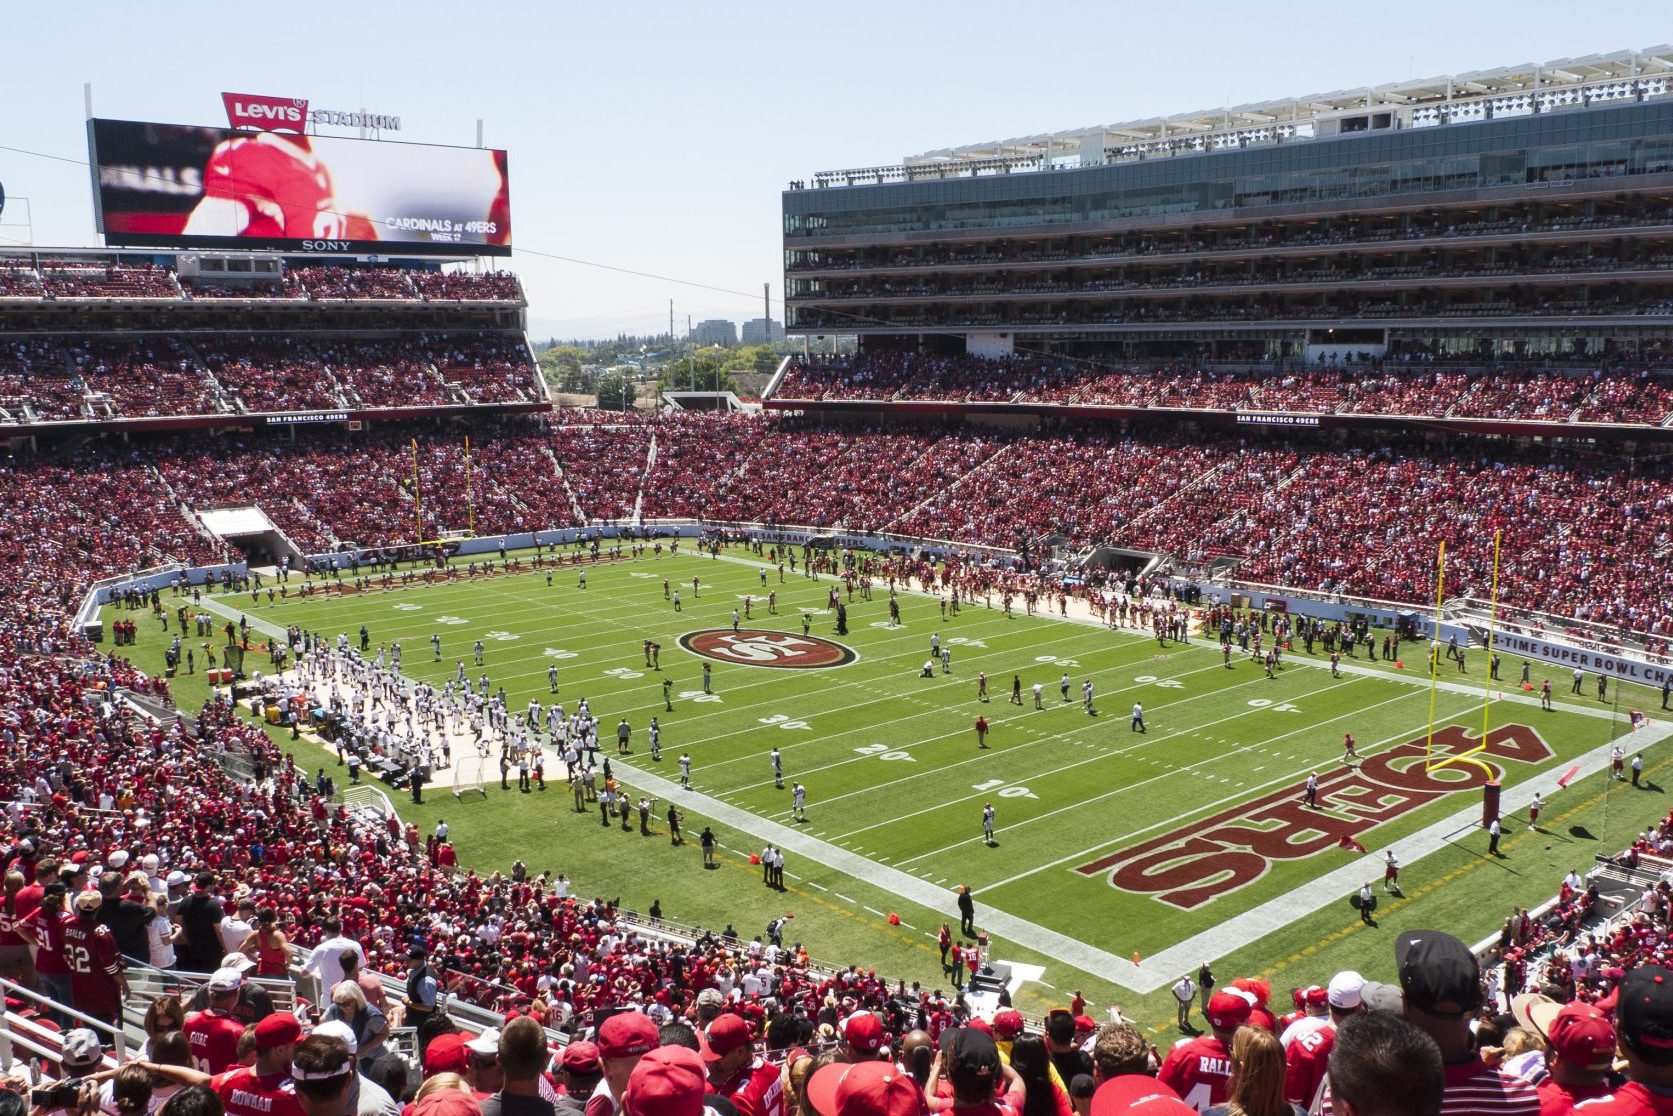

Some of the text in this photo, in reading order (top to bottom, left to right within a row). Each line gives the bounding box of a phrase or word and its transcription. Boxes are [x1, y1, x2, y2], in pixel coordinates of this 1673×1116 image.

[313, 109, 401, 131] STADIUM
[386, 216, 497, 234] CARDINALS AT 49ERS
[302, 240, 351, 251] SONY
[430, 233, 453, 242] WEEK
[1252, 415, 1294, 424] FRANCISCO
[1295, 417, 1319, 425] 49ERS
[1542, 645, 1589, 665] SUPER
[1594, 657, 1638, 677] BOWL
[603, 667, 645, 679] 50
[758, 714, 808, 730] 30
[853, 743, 909, 761] 20
[971, 779, 1030, 798] 10
[63, 944, 91, 973] 32
[761, 976, 767, 988] 5
[230, 1089, 273, 1113] BOWMAN
